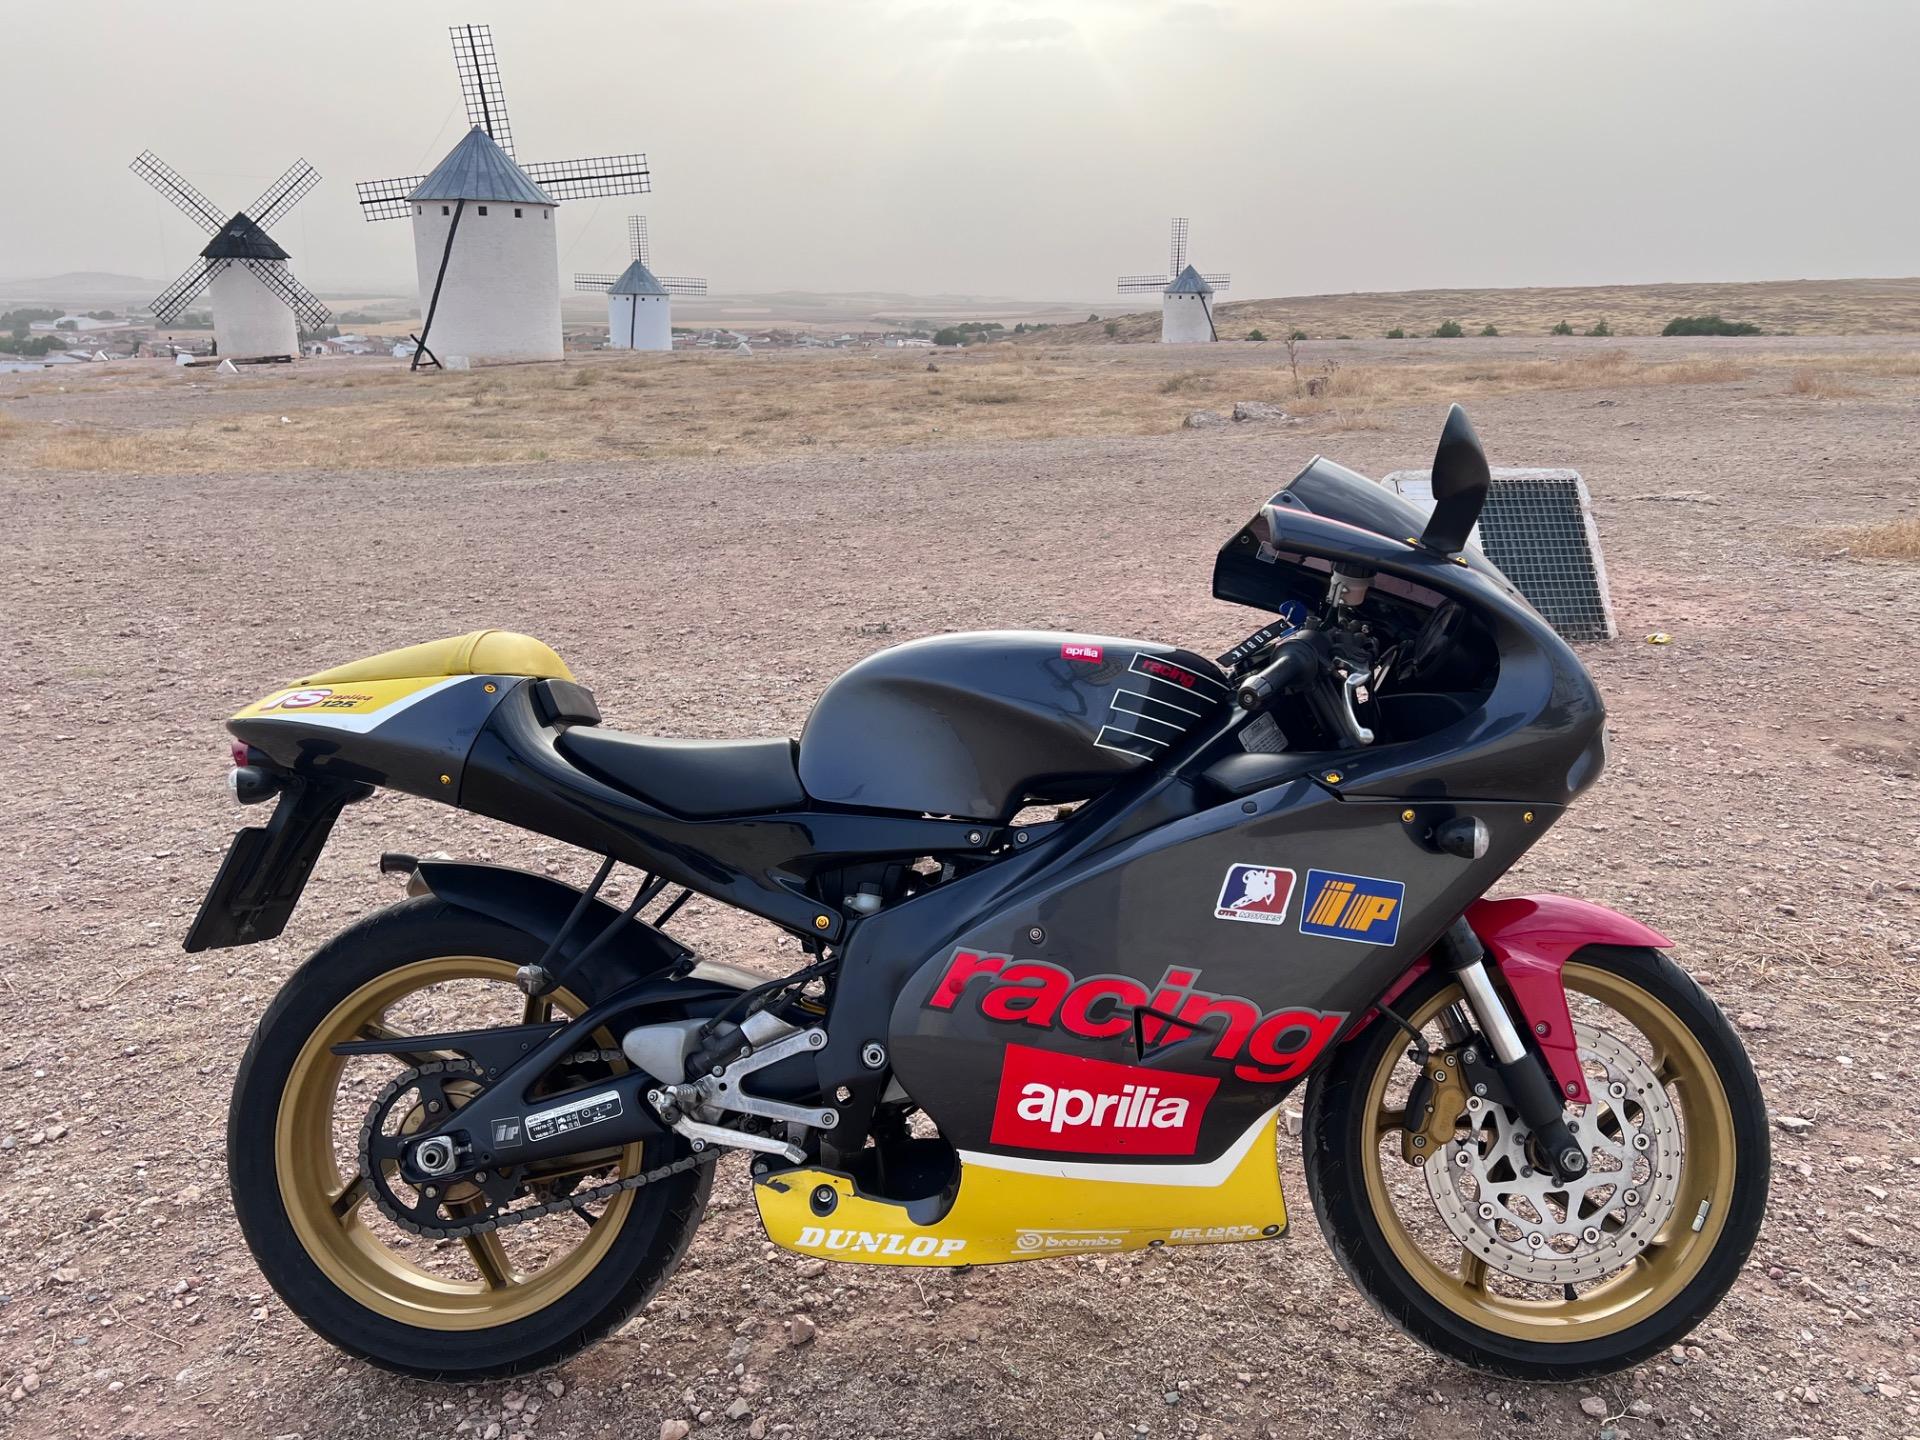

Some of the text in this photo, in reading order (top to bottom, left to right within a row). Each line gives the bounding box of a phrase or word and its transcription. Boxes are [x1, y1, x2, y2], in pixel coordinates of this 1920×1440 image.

[1065, 646, 1099, 659] aprilia
[1141, 658, 1198, 688] racing
[320, 700, 357, 708] 125
[922, 947, 1349, 1084] racing
[1016, 1082, 1191, 1133] aprilia
[794, 1226, 967, 1257] DUNLOP
[1044, 1236, 1123, 1248] brembo
